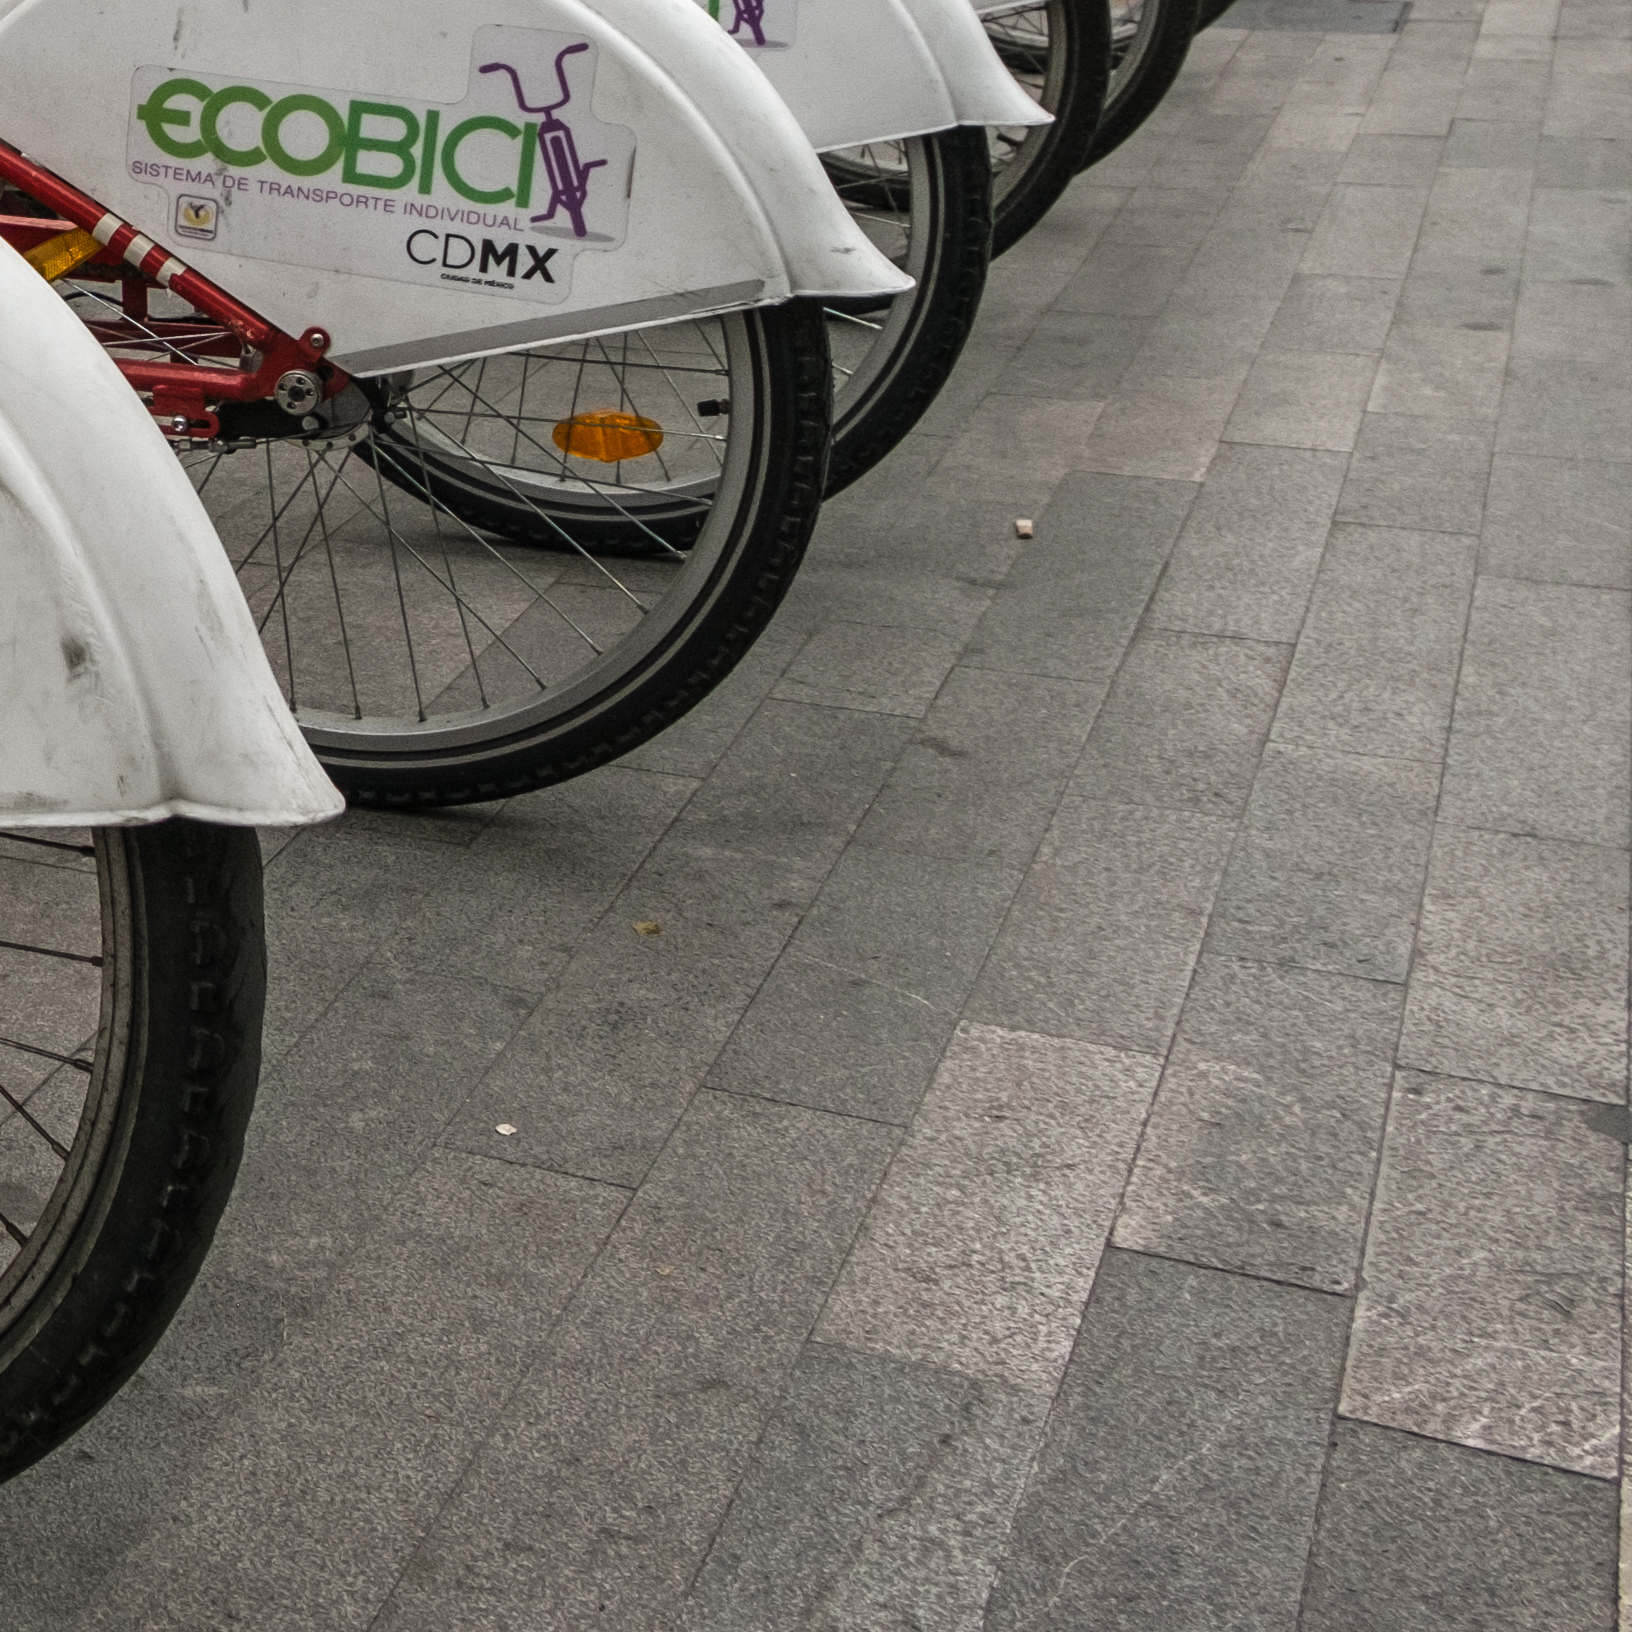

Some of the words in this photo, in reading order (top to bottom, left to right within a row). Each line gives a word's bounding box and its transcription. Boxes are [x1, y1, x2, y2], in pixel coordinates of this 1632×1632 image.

[136, 78, 539, 208] ECOBICI
[132, 160, 215, 188] SISTEMA
[222, 174, 249, 192] DE
[255, 179, 396, 214] TRANSPORTE
[403, 202, 526, 232] INDIVIDUAL
[406, 229, 559, 284] CDMX
